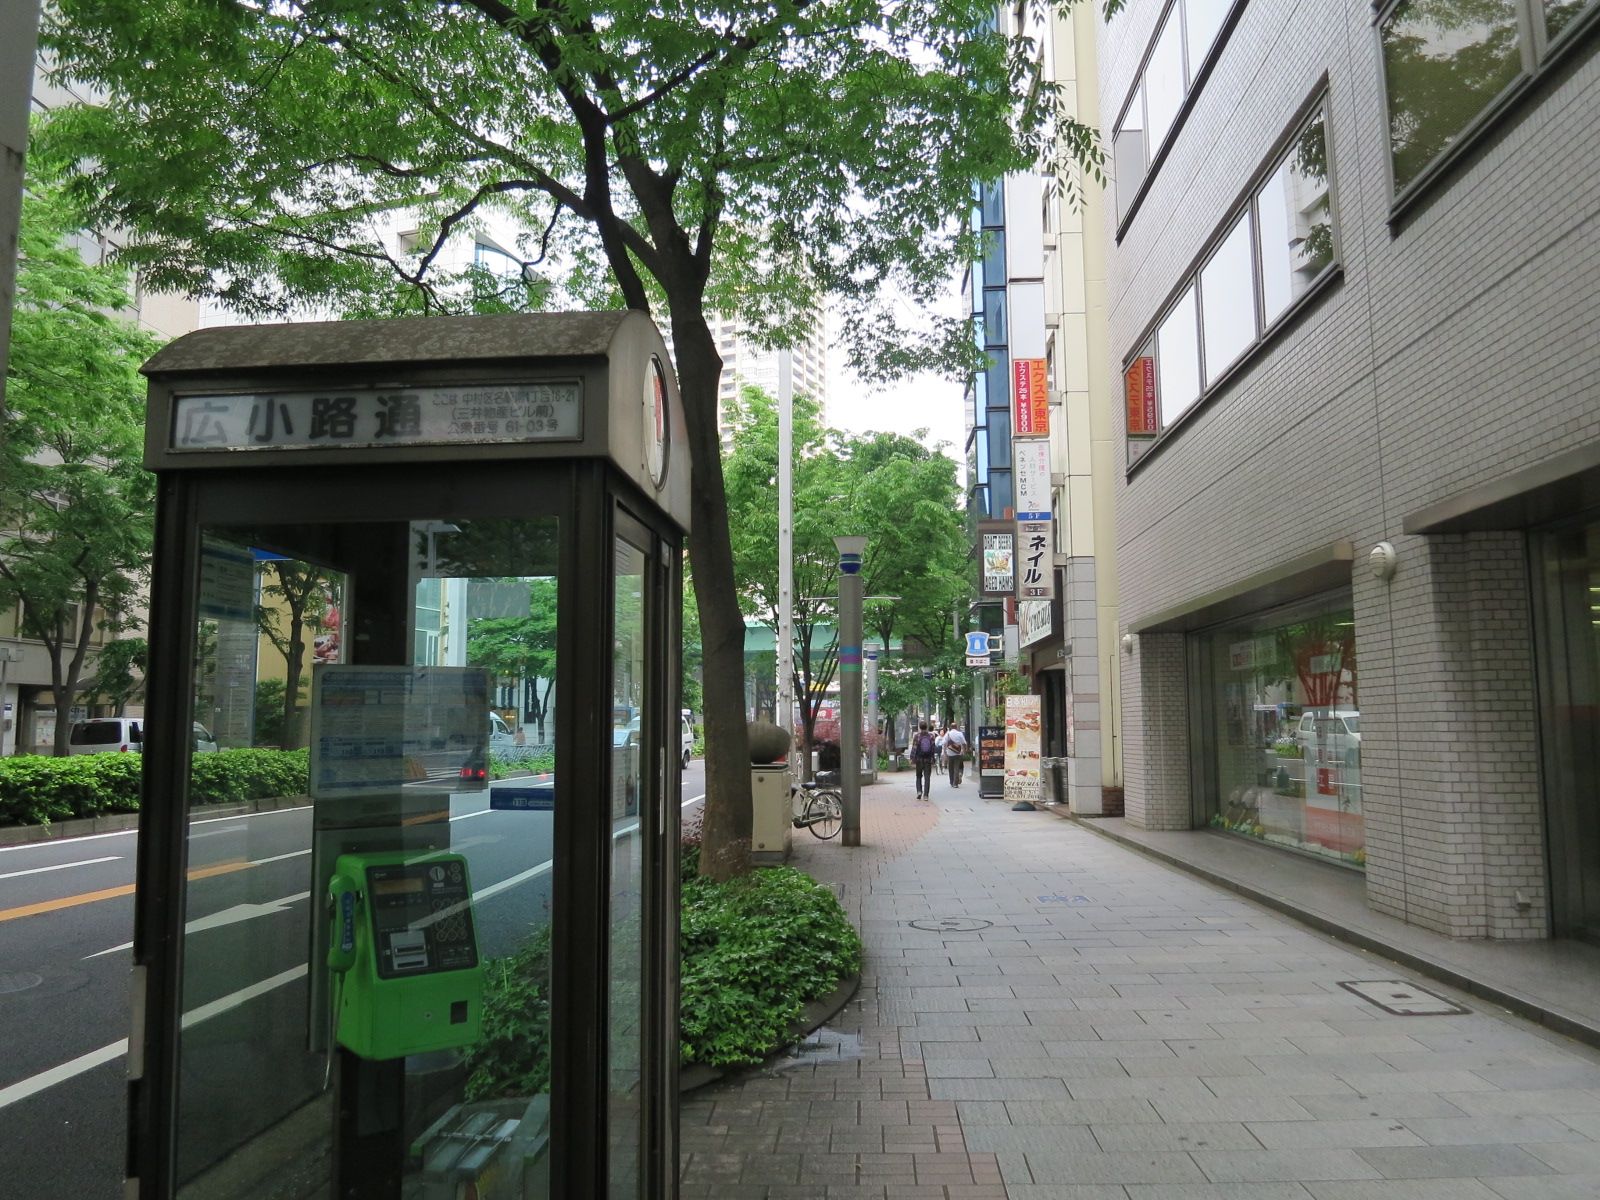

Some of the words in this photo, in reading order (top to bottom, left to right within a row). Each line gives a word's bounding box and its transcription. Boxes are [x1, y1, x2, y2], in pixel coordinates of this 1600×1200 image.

[181, 394, 422, 445] 広小路通
[1033, 361, 1047, 432] エクステ東京
[1024, 535, 1046, 583] ネイル
